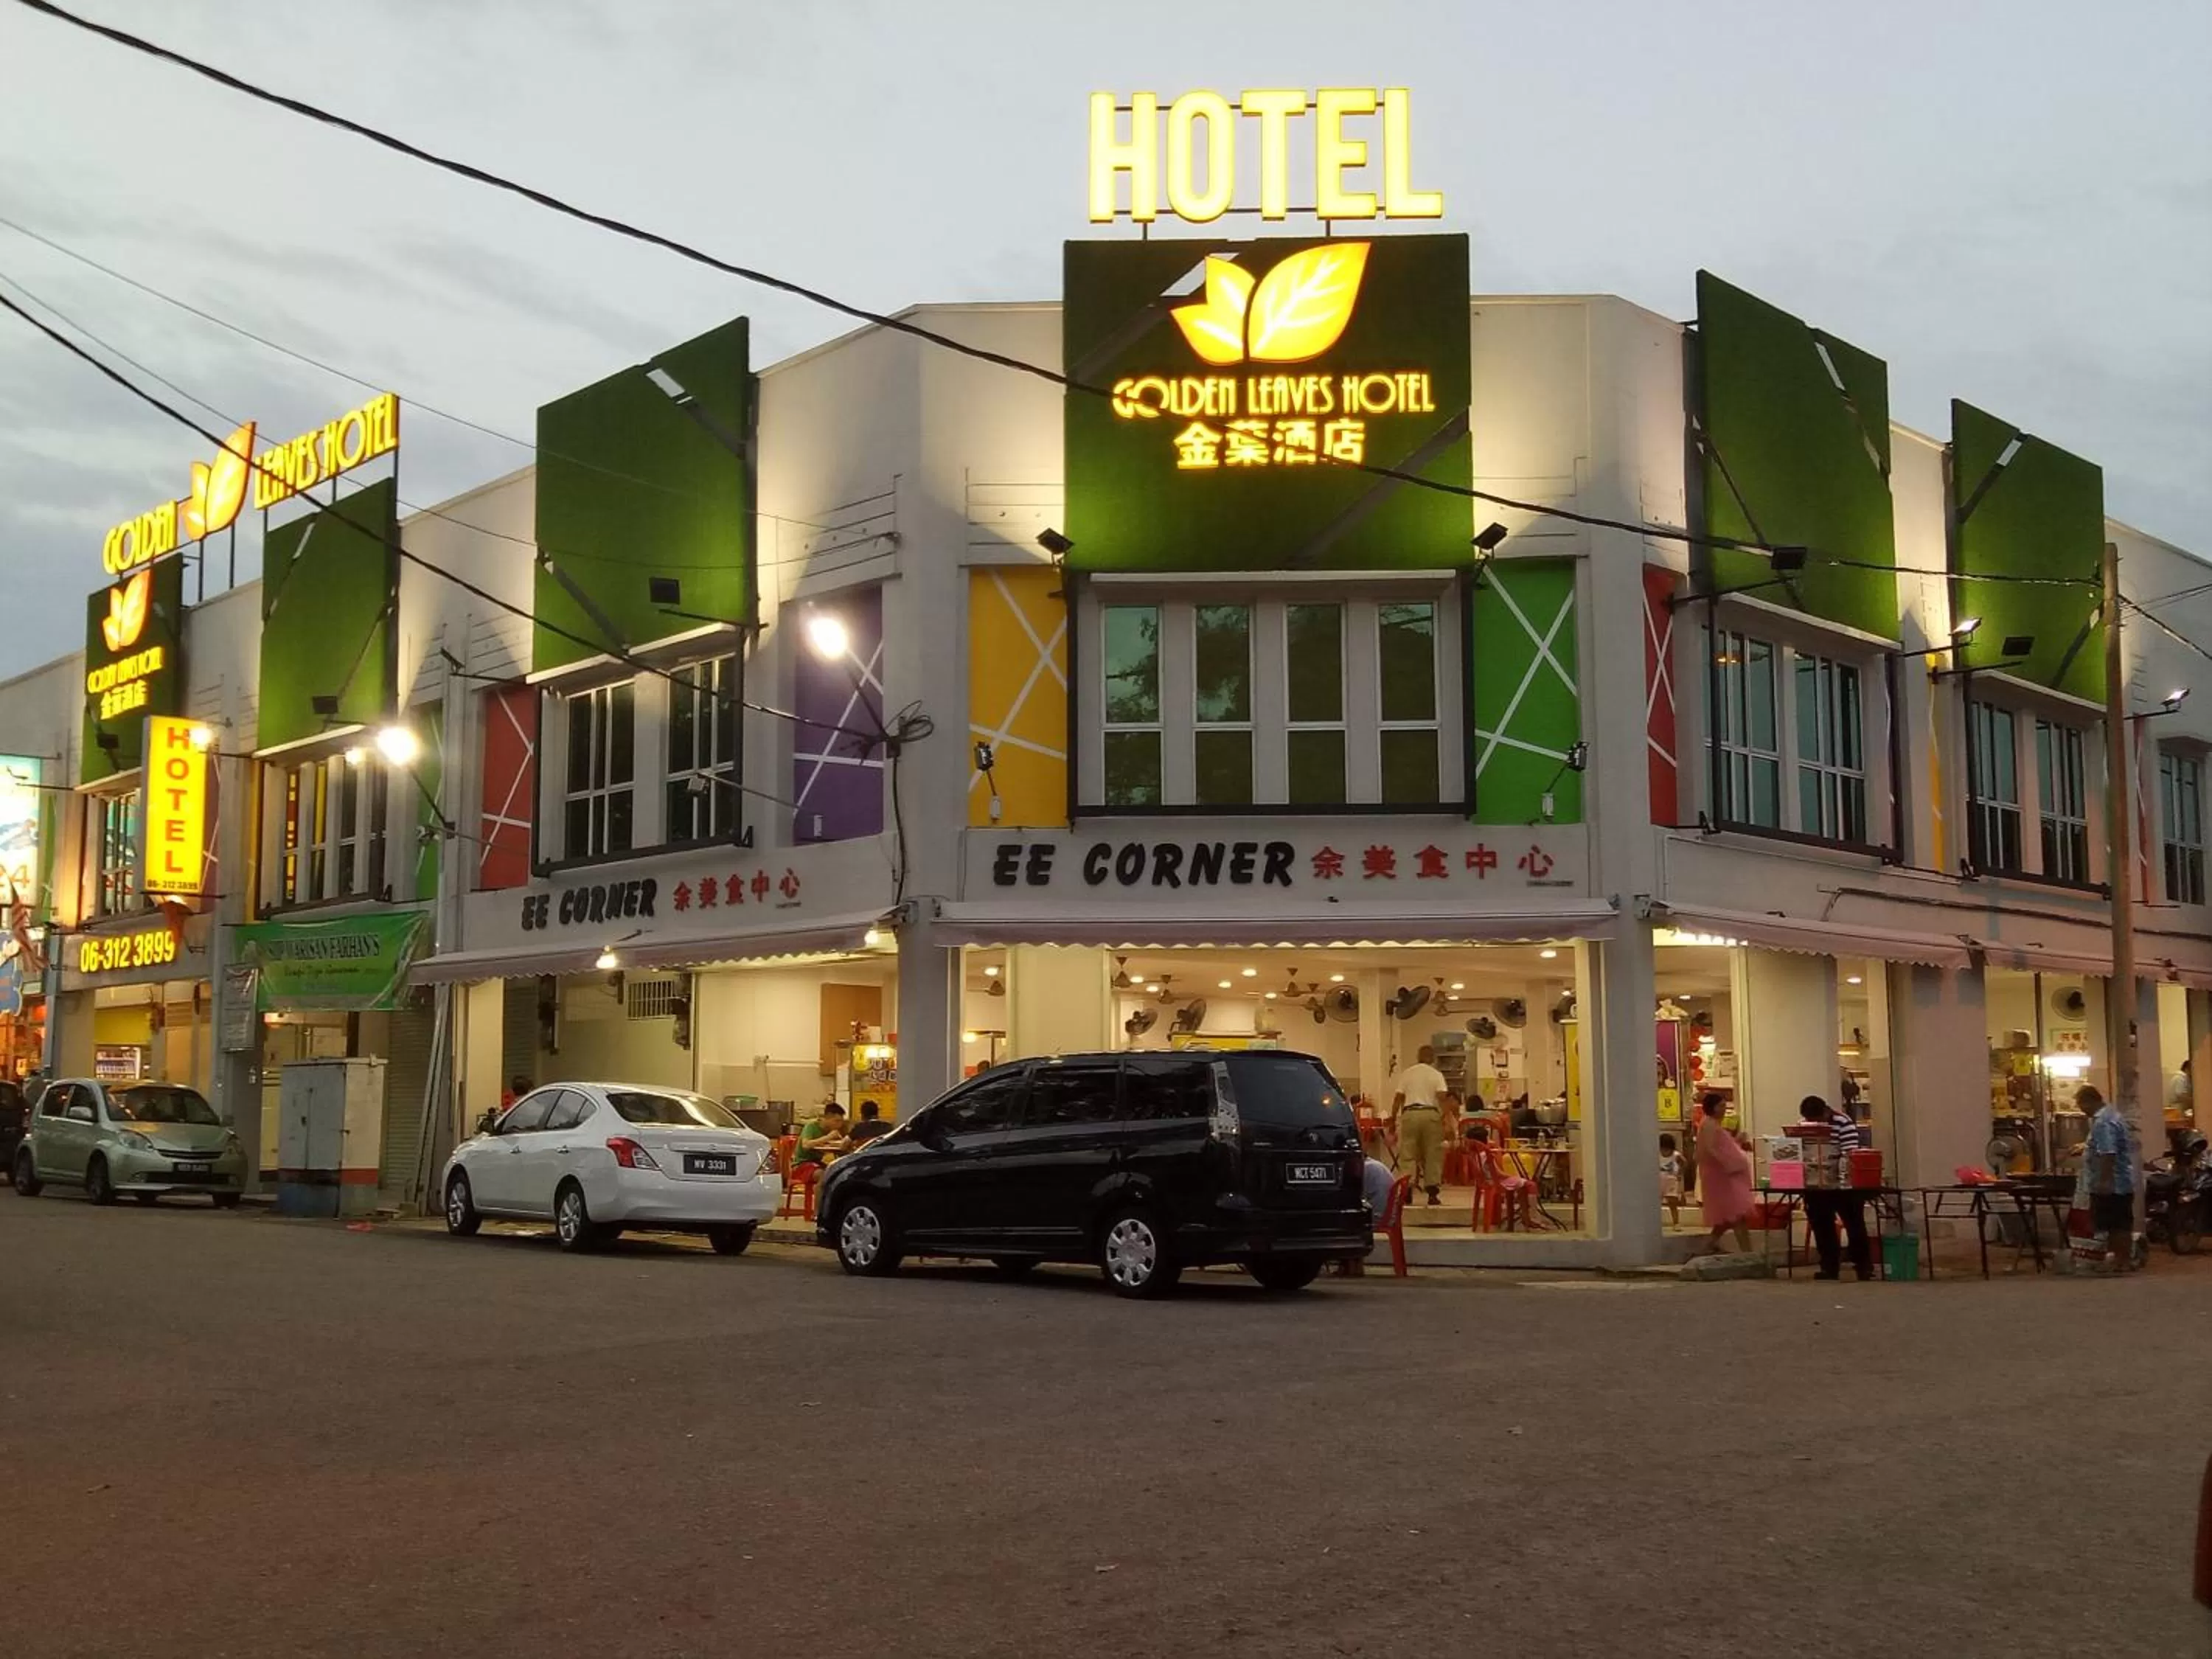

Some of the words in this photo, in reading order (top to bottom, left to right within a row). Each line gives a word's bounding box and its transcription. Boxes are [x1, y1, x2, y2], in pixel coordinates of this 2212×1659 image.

[1089, 88, 1442, 222] HOTEL
[1112, 377, 1237, 418] GOLDEN
[1248, 375, 1335, 414] LEAVES
[1342, 372, 1436, 414] HOTEL
[1173, 417, 1366, 470] 金葉酒店
[102, 499, 178, 575] GOLDEN
[254, 429, 321, 510] LEAVES
[323, 392, 400, 478] HOTEL
[164, 726, 191, 874] HOTEL
[993, 844, 1057, 886] EE
[1082, 841, 1296, 889] CORNER
[521, 893, 551, 932] EE
[558, 877, 658, 926] CORNER
[80, 936, 131, 973] 06-312
[133, 931, 175, 967] 3899
